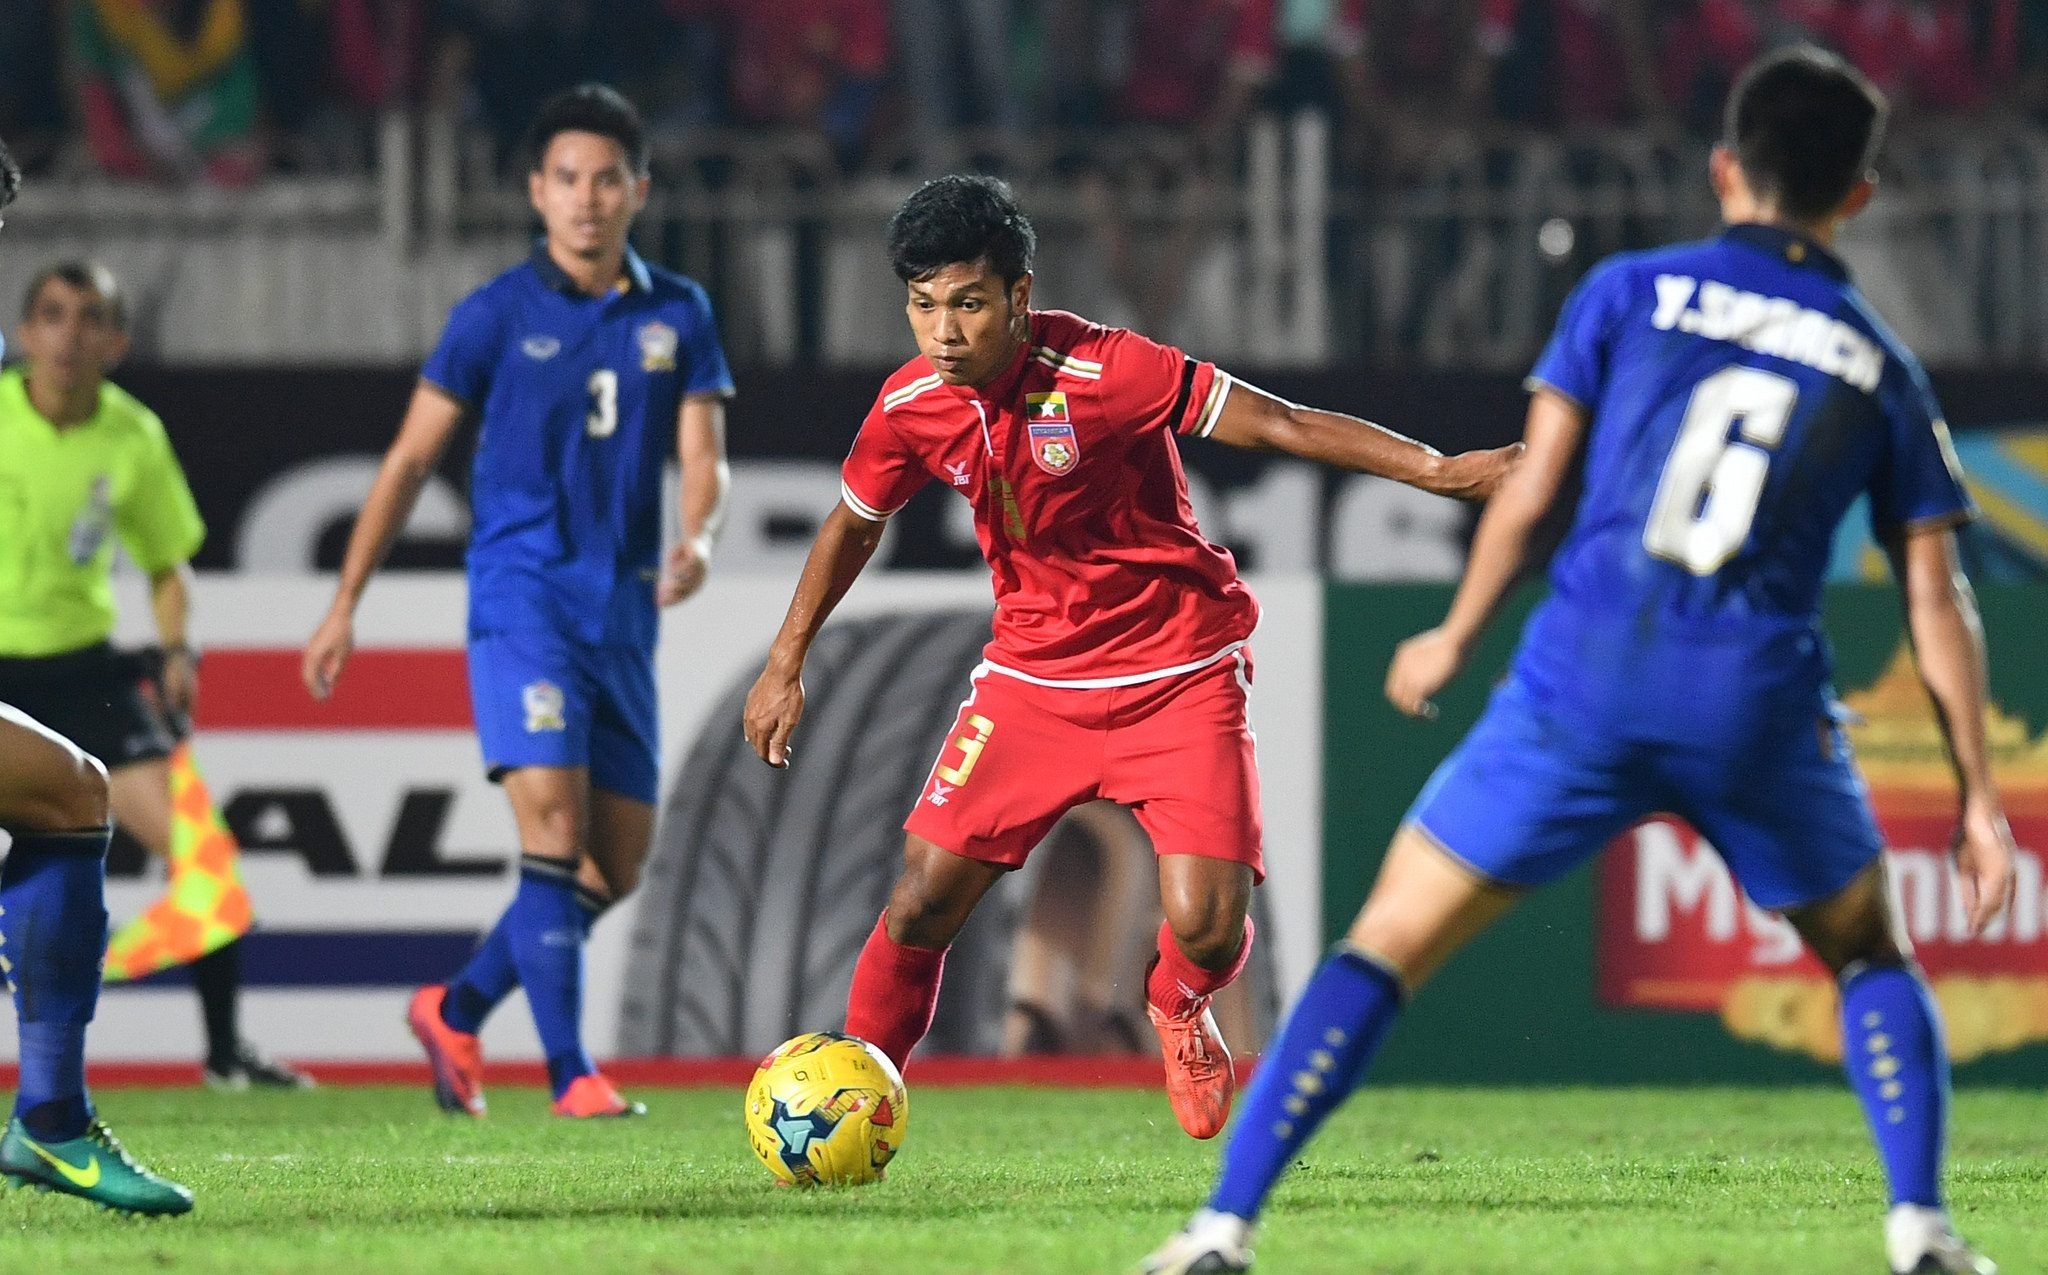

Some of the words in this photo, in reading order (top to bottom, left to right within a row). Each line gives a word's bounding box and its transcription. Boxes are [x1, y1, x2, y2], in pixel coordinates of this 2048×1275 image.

[586, 368, 618, 440] 3
[1642, 364, 1799, 577] 6
[937, 713, 995, 787] 3
